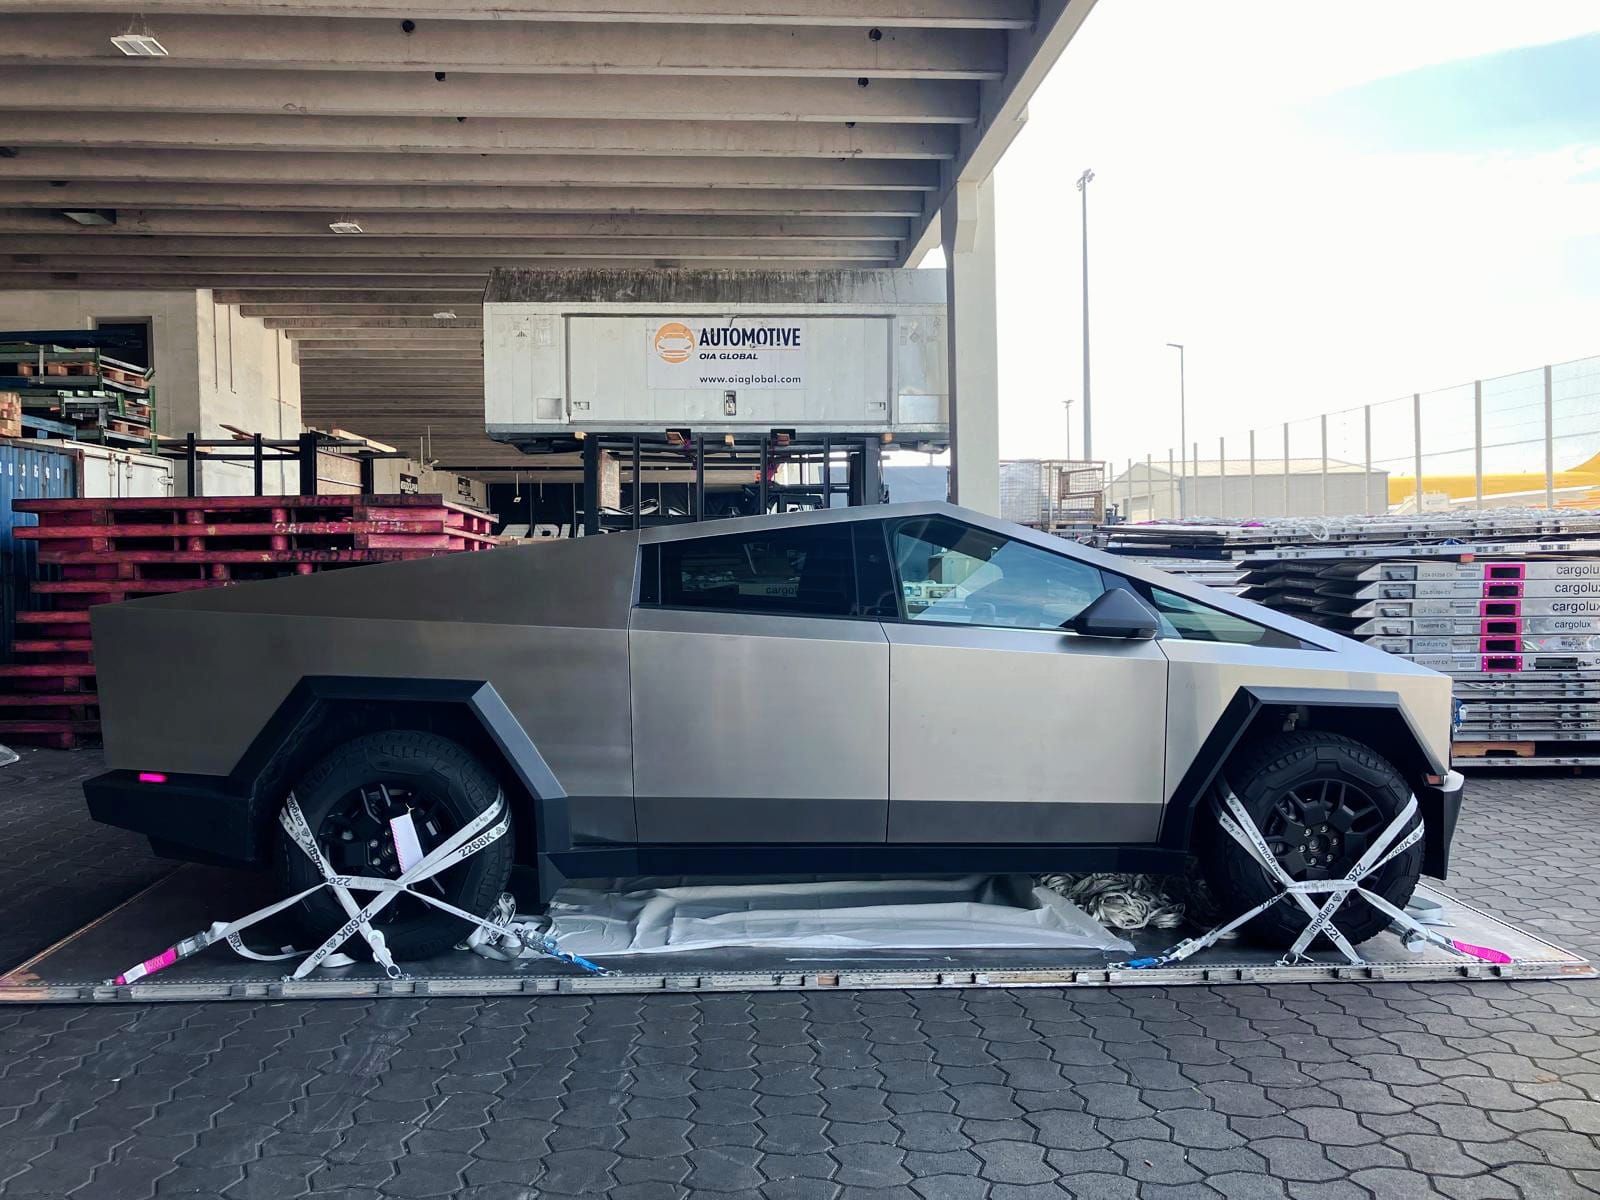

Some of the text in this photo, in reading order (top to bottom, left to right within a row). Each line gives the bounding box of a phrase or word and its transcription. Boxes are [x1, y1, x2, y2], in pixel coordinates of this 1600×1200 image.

[699, 374, 801, 385] www.oiaglobal.com
[1554, 620, 1592, 630] cargolux
[458, 832, 495, 857] 2268K
[337, 908, 372, 940] 2268K
